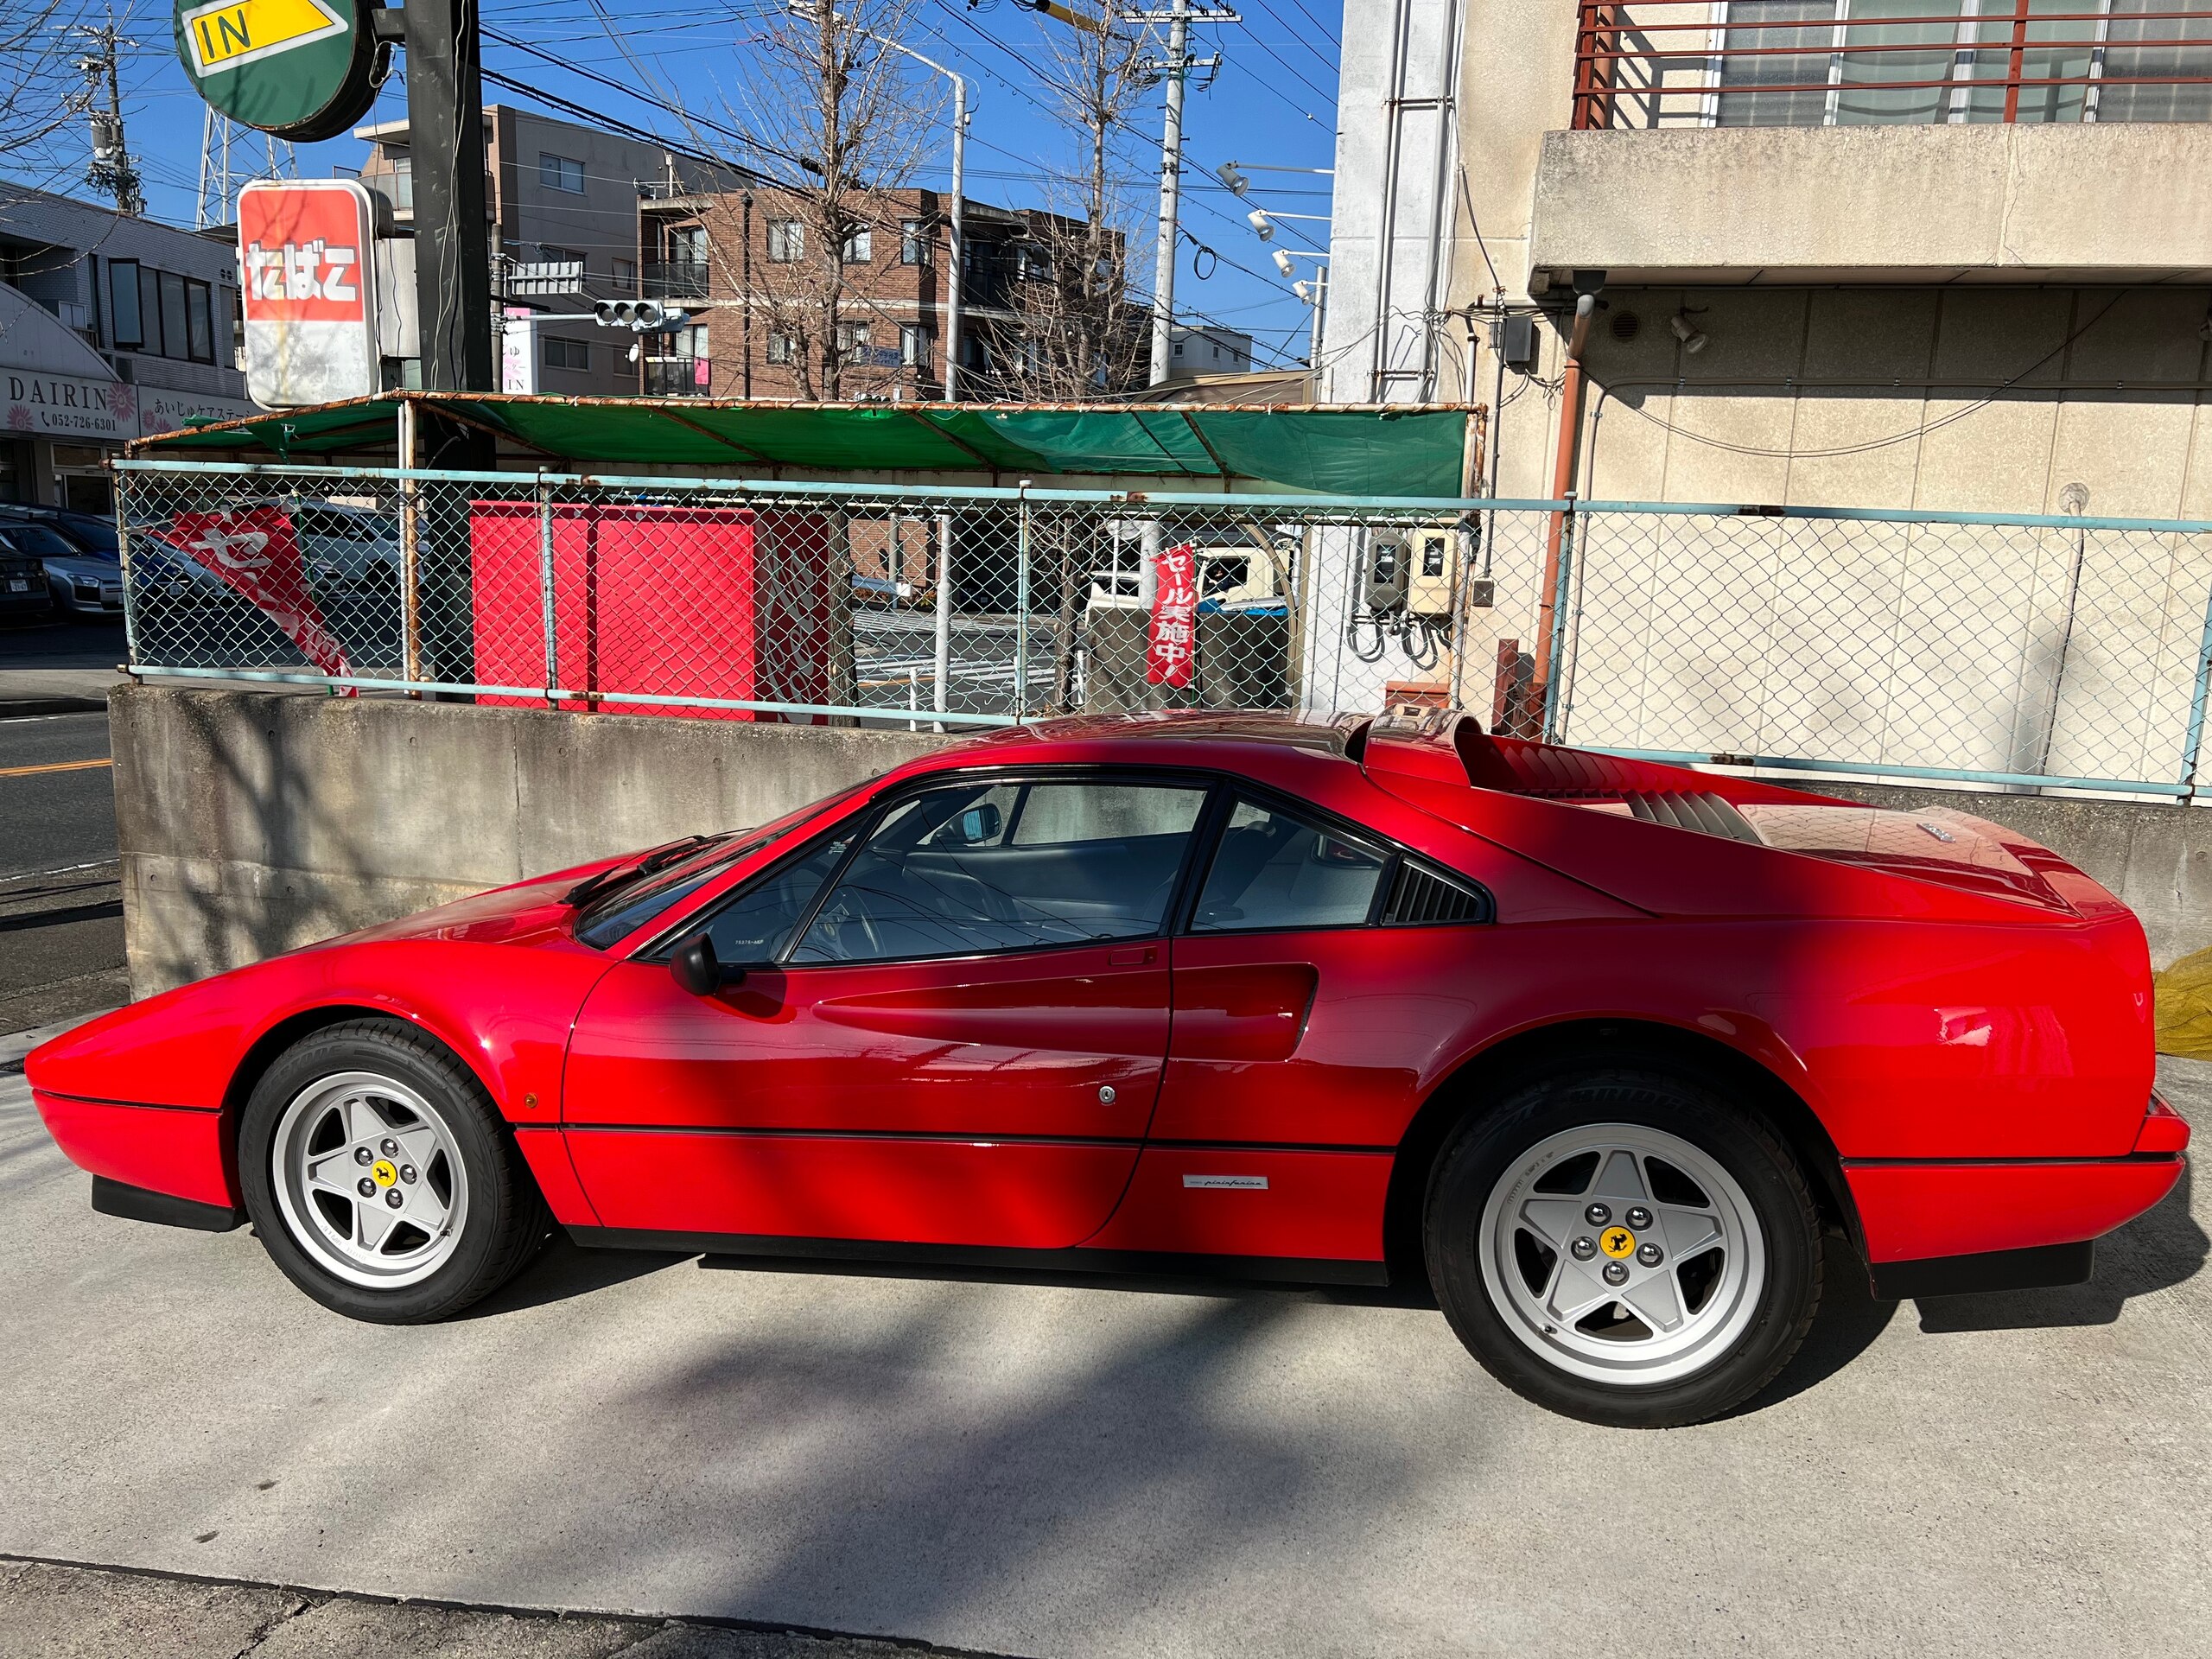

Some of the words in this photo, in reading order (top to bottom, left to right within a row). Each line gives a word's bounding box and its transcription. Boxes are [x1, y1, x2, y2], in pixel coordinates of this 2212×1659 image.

[200, 9, 251, 60] IN
[245, 239, 357, 302] たばこ
[9, 377, 107, 411] DAIRIN
[51, 412, 117, 432] 052-726-6301
